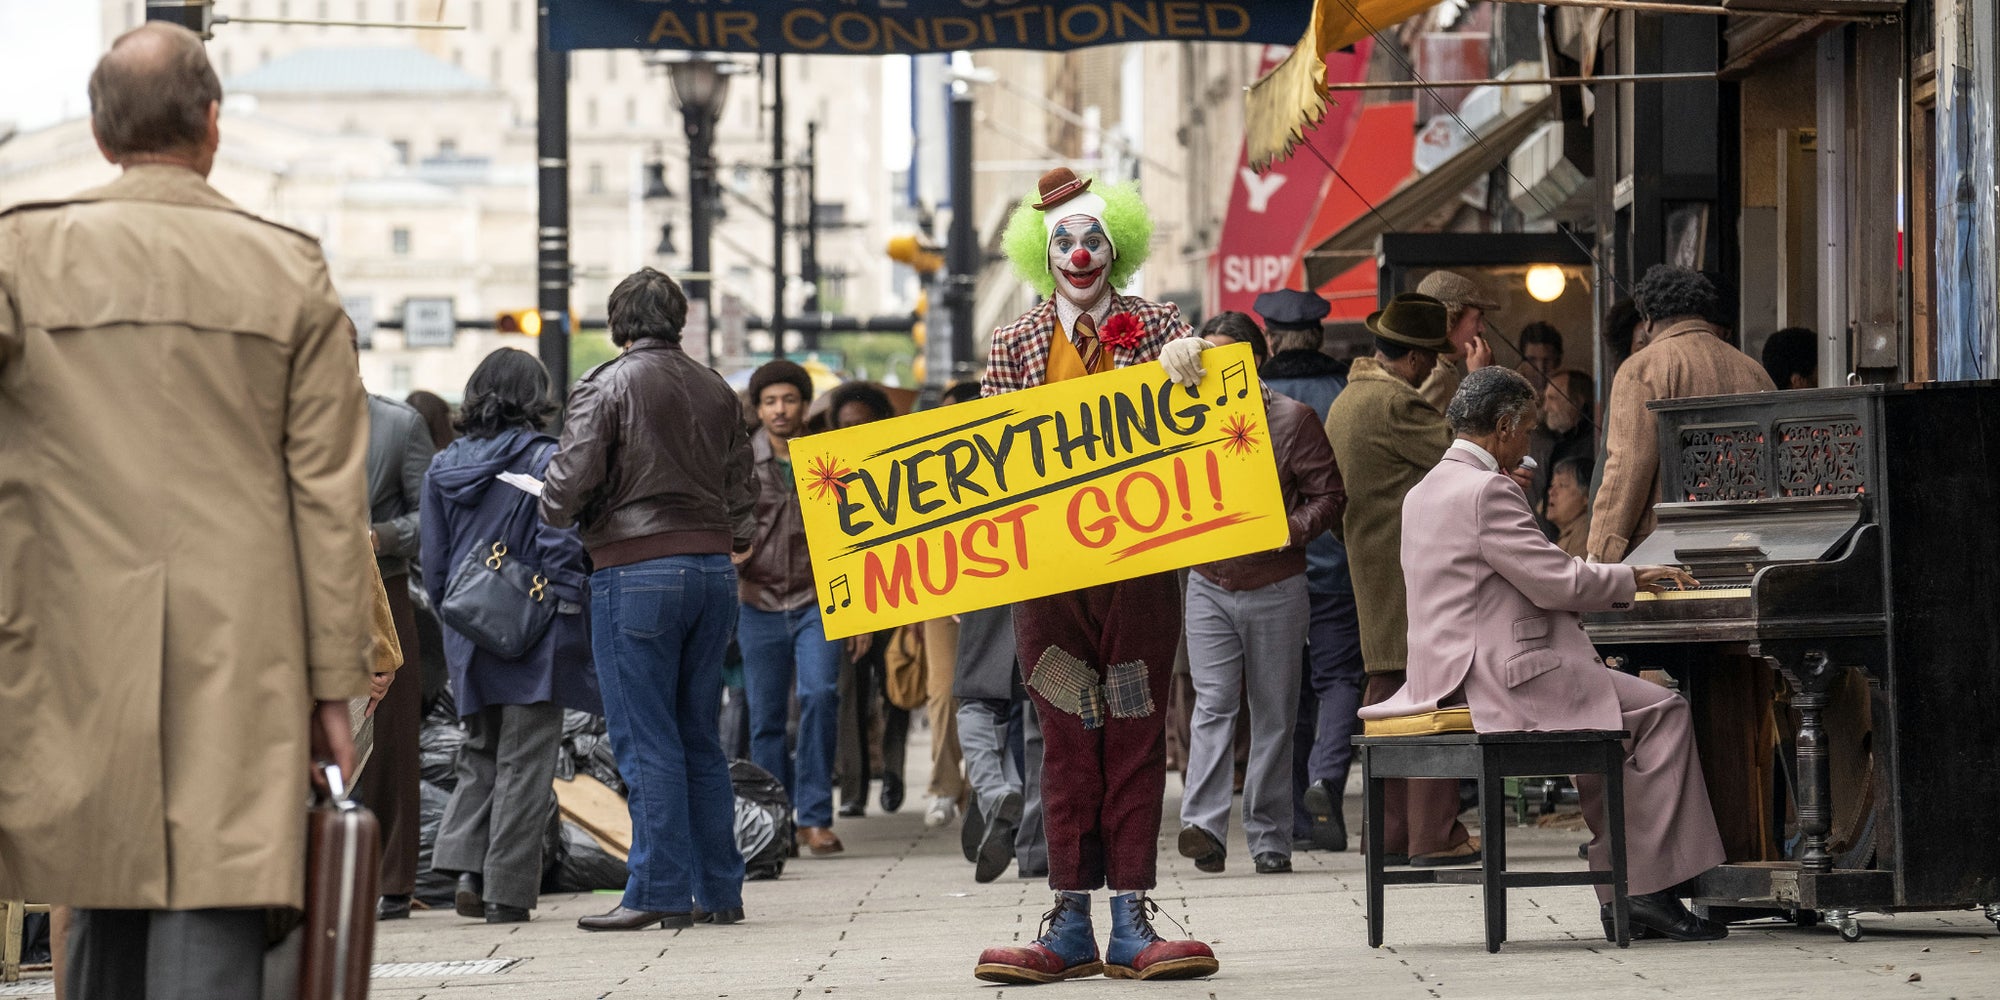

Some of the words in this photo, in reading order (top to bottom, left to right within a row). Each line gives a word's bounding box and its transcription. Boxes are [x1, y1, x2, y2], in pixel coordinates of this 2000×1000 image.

[650, 9, 759, 48] AIR
[781, 3, 1251, 51] CONDITIONED
[1241, 166, 1287, 213] Y
[836, 378, 1211, 536] EVERYTHING
[864, 504, 1039, 613] MUST
[1066, 449, 1224, 549] GO!!
